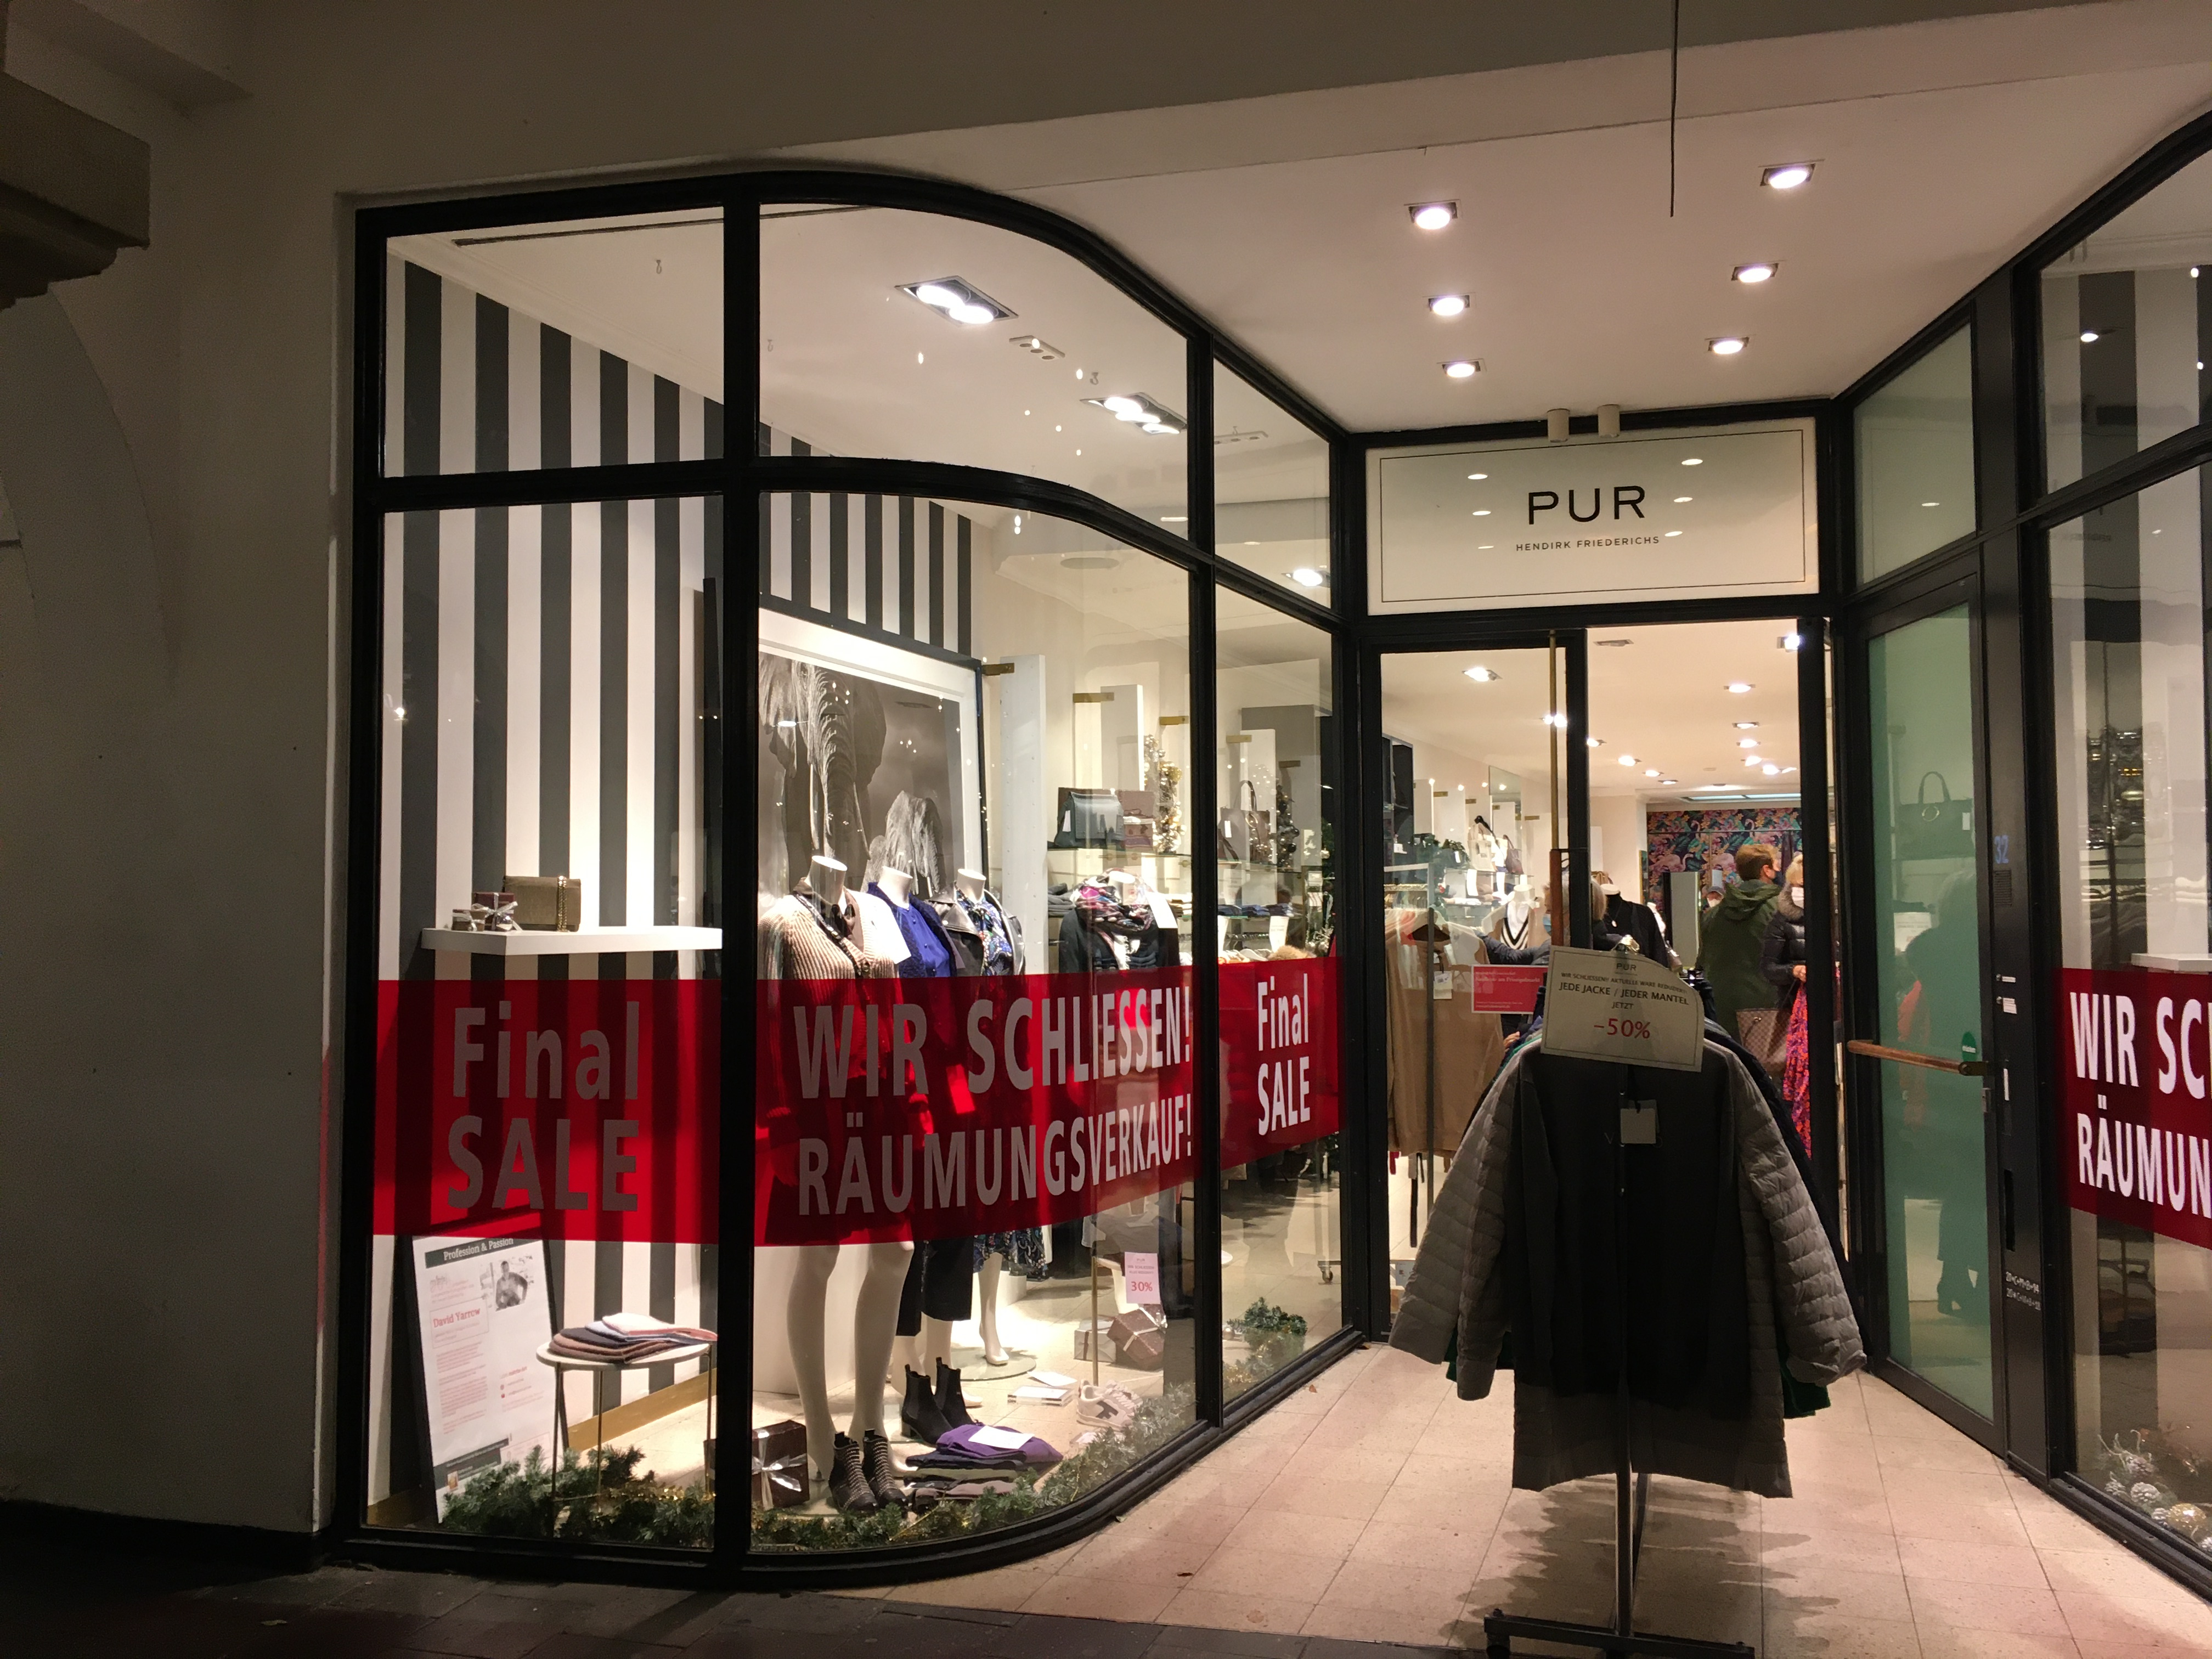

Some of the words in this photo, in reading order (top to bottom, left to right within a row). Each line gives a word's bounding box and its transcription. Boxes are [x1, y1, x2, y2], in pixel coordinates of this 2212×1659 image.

[1528, 485, 1645, 525] PUR
[1516, 541, 1571, 551] HENDIRK
[1577, 536, 1660, 548] FRIEDERICHS
[1994, 835, 2010, 864] 32
[1616, 963, 1637, 972] PUR
[1559, 982, 1579, 992] JEDE
[1581, 985, 1610, 995] JACKE
[1620, 989, 1648, 999] JEDER
[1651, 991, 1689, 1006] MANTEL
[1258, 974, 1310, 1051] Final
[1594, 1018, 1651, 1039] -50%
[453, 1001, 639, 1099] Final
[793, 1003, 928, 1098] WIR
[967, 986, 1191, 1094] SCHLIESSEN!
[2070, 992, 2139, 1087] WIR
[1258, 1056, 1311, 1136] SALE
[447, 1115, 639, 1211] SALE
[799, 1093, 1192, 1215] RÄUMUNGSVERKAUF!
[443, 1245, 480, 1261] Profession
[481, 1243, 487, 1251] &
[489, 1238, 514, 1251] Passion
[1131, 1281, 1153, 1292] 30%
[433, 1314, 454, 1328] David
[455, 1308, 481, 1320] Yarrow
